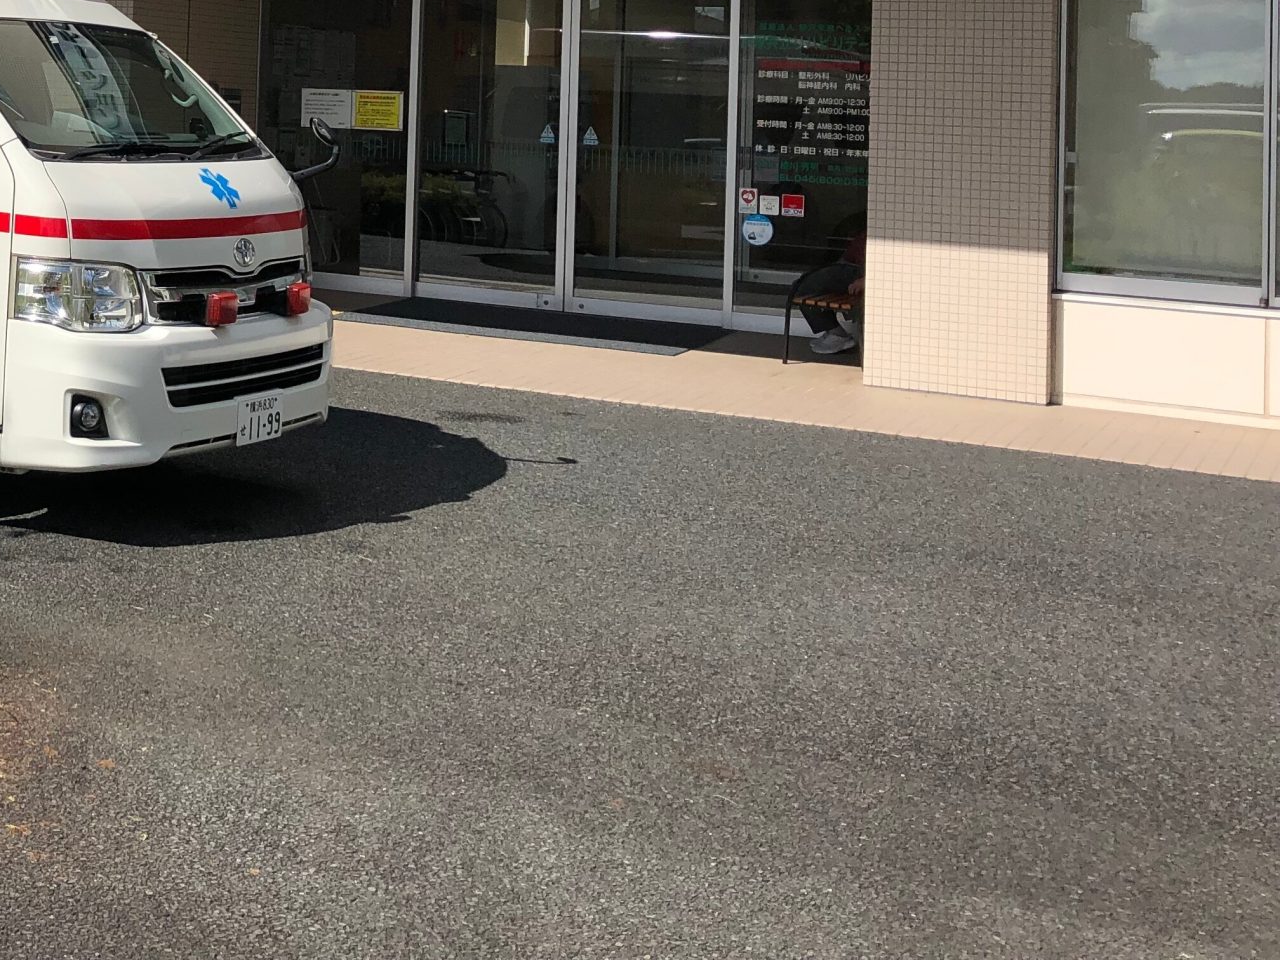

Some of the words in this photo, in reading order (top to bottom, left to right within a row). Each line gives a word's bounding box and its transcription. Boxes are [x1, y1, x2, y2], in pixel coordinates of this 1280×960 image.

[802, 105, 811, 114] 土
[801, 131, 810, 140] 土
[249, 411, 281, 440] 11-99
